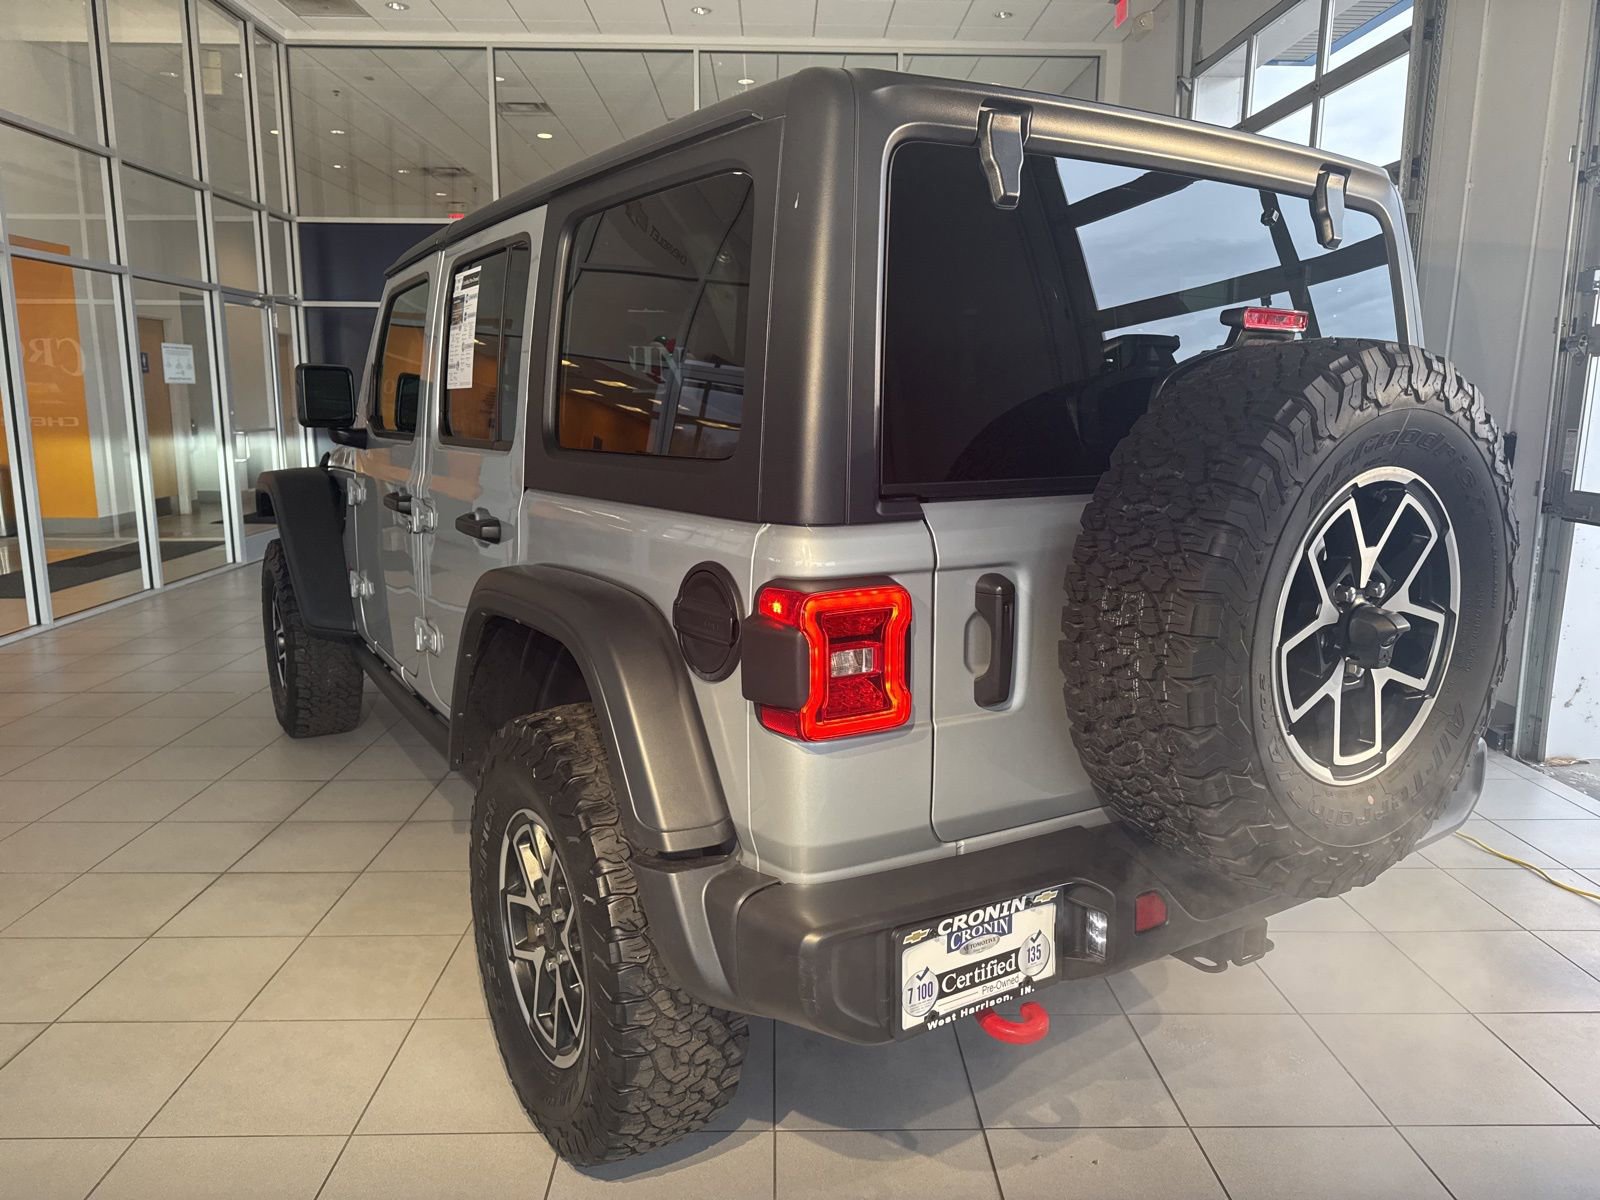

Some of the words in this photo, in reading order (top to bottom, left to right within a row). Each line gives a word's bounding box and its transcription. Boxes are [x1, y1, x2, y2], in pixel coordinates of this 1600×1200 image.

[938, 896, 1027, 935] CRONIN
[950, 916, 1010, 950] CRONIN
[1027, 944, 1042, 964] 135
[942, 954, 1017, 993] Certified
[982, 975, 1020, 995] Pre-Owned
[927, 1014, 957, 1031] West
